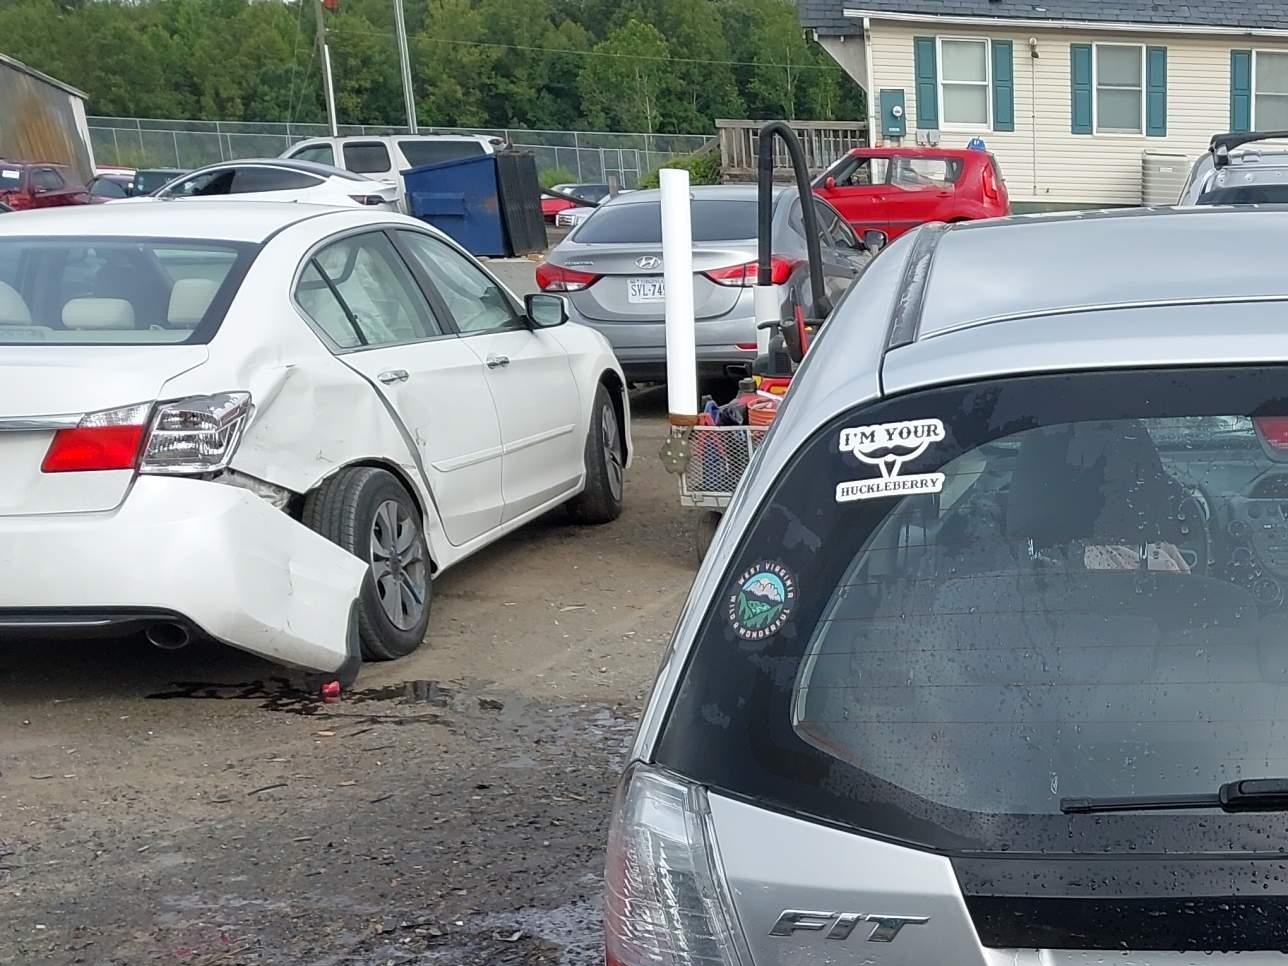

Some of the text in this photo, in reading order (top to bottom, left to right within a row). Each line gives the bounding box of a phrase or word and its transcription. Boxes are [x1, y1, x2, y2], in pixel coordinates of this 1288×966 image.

[844, 423, 940, 447] I'M YOUR
[840, 478, 940, 497] HUCKLEBERRY
[738, 561, 794, 598] WEST VIRGINIA
[729, 595, 737, 620] WILD
[739, 609, 790, 638] WONDERFUL
[768, 909, 930, 942] FIT
